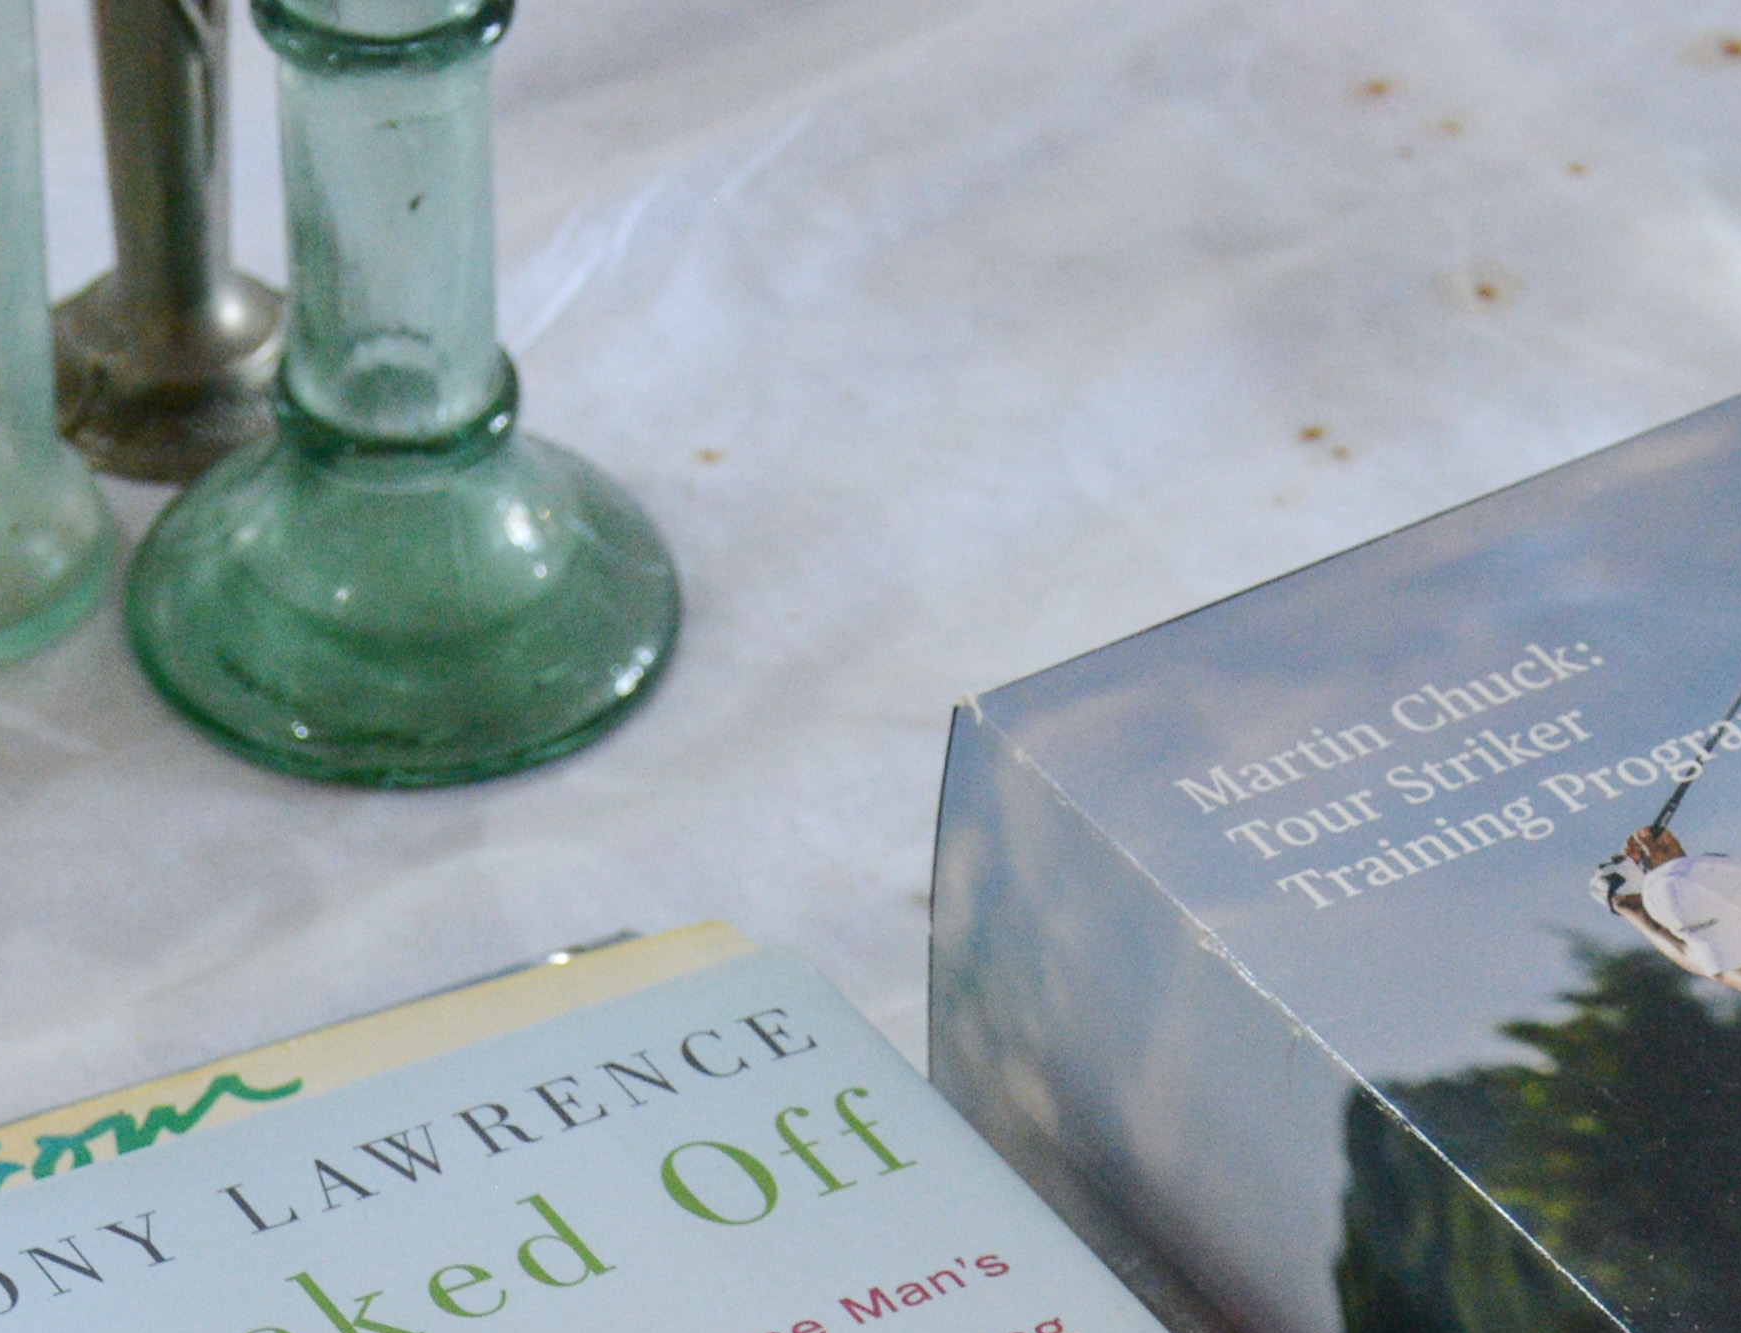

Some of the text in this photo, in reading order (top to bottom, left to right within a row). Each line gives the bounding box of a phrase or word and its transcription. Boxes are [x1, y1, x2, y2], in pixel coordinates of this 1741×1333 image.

[1173, 637, 1607, 816] Martin Chuck:
[1223, 707, 1595, 862] Tour Striker
[1276, 794, 1555, 912] Training
[217, 1006, 820, 1234] LAWRENCE
[659, 1086, 919, 1227] Off
[837, 1253, 1010, 1327] Man's
